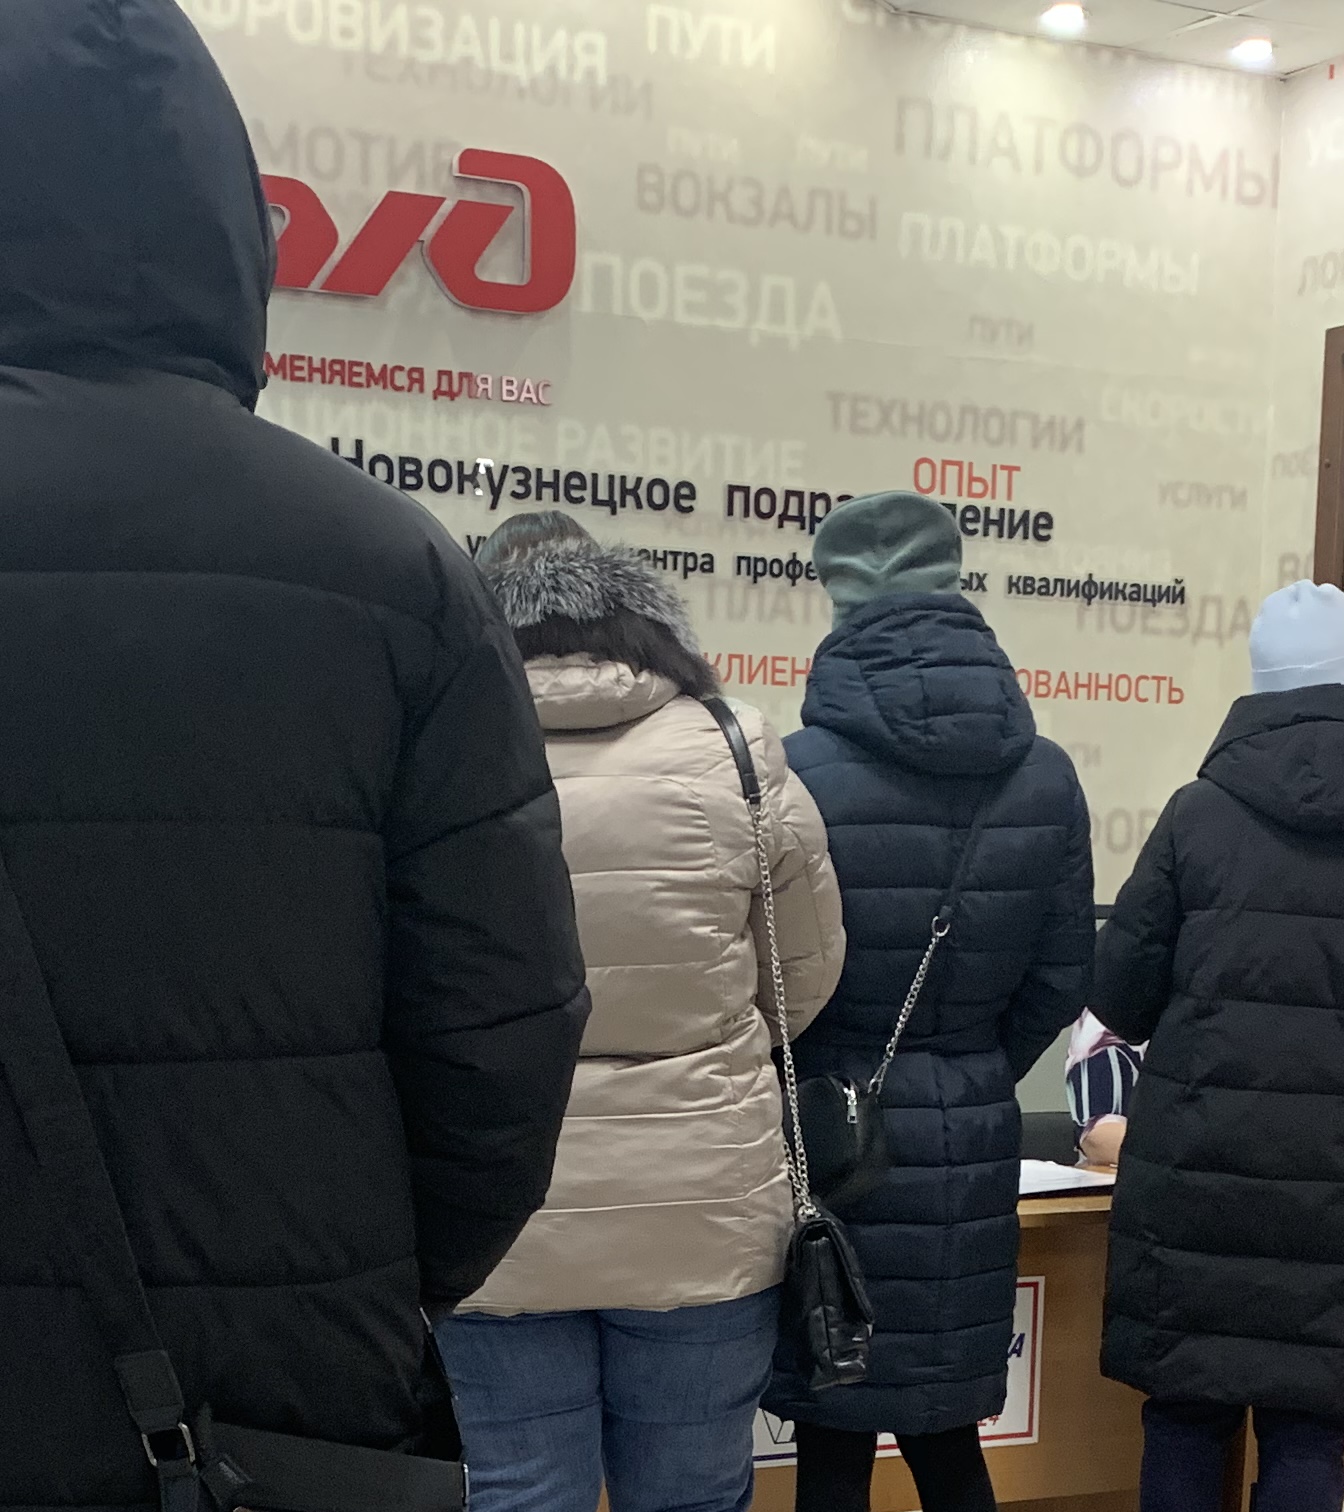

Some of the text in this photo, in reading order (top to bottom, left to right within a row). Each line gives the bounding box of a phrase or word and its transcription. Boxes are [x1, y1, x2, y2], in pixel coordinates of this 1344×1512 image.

[646, 4, 777, 73] ПУТИ
[892, 95, 1283, 211] ПЛАТФОРМЫ
[635, 161, 879, 242] ВОКЗАЛЫ
[897, 210, 1201, 296] ПЛАТФОРМЫ
[580, 250, 844, 347] ПОЕЗДА
[433, 369, 493, 401] ДЛЯ
[825, 389, 1086, 456] ТЕХНОЛОГИИ
[913, 457, 1021, 502] ОПЫТ
[1007, 573, 1186, 608] квалификаций
